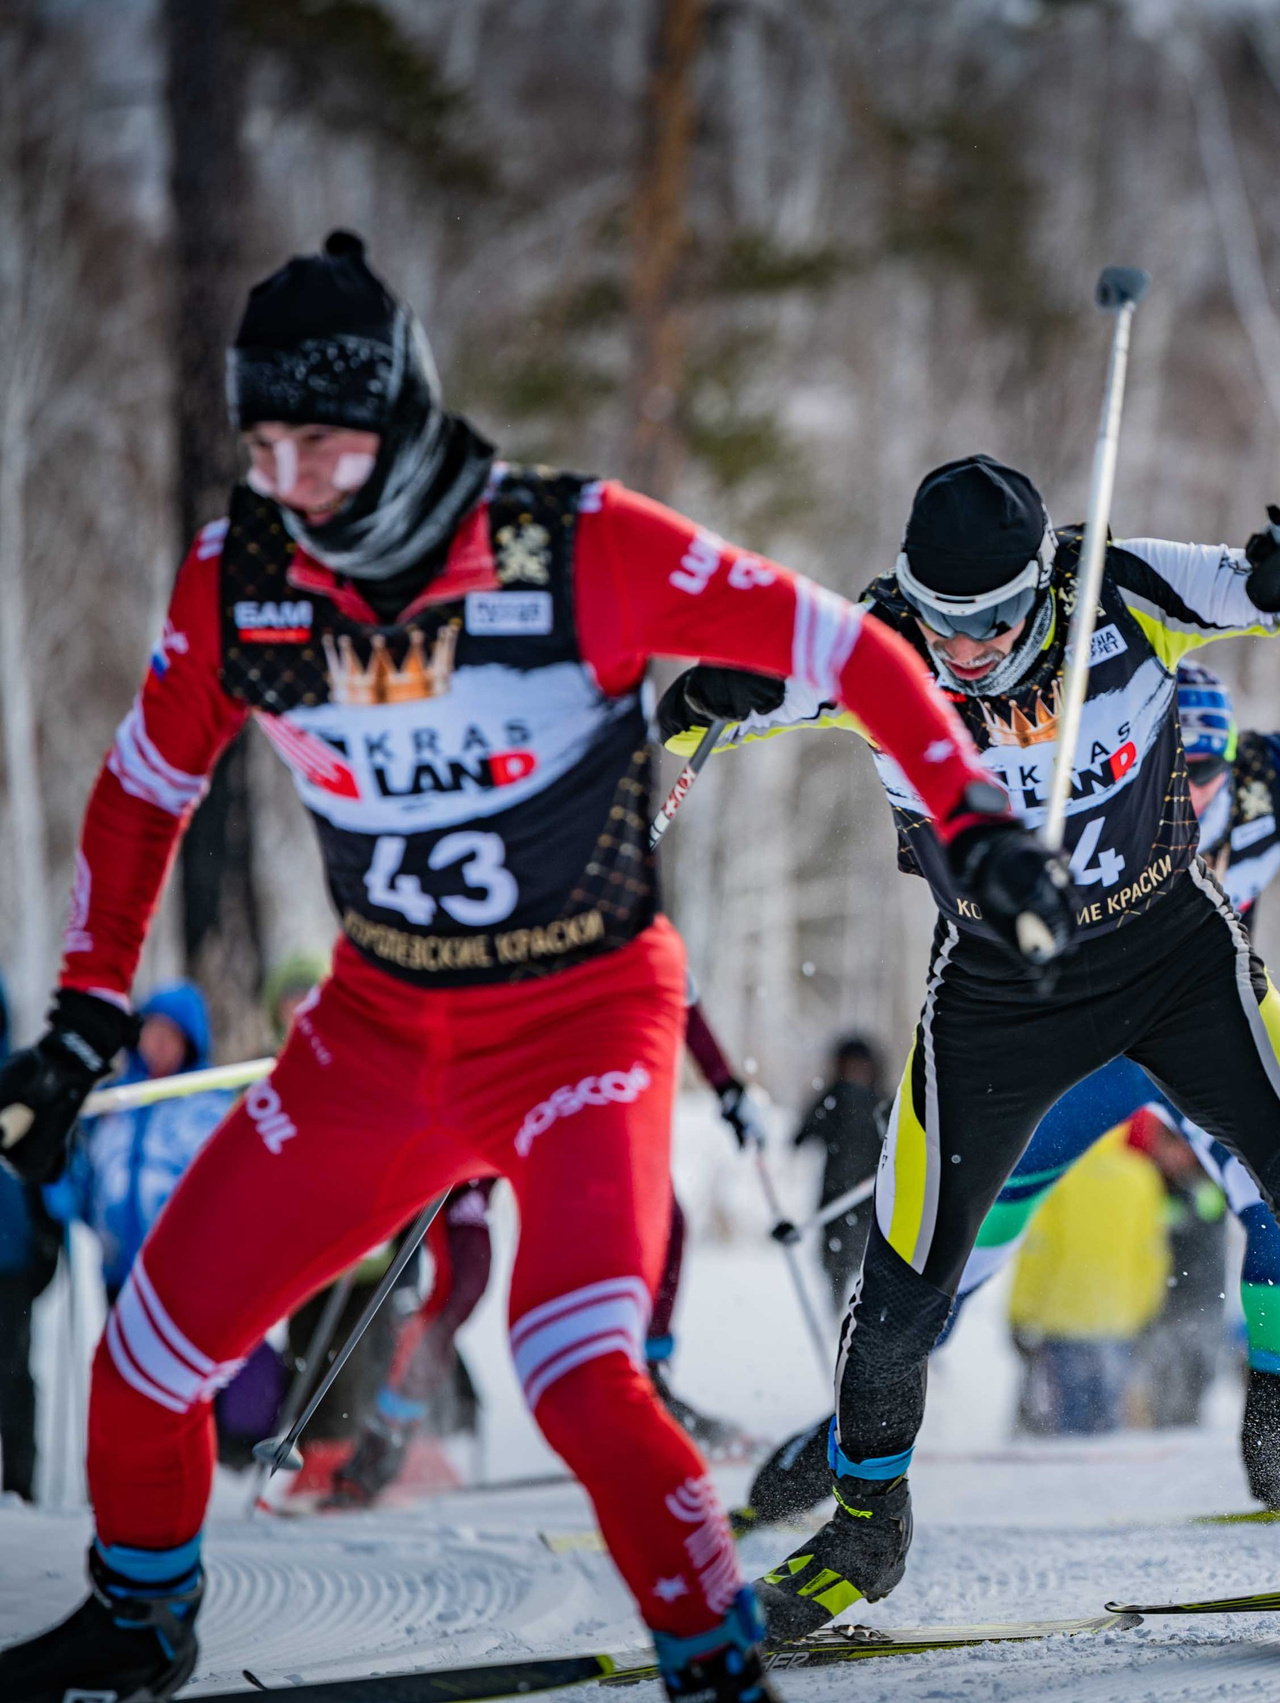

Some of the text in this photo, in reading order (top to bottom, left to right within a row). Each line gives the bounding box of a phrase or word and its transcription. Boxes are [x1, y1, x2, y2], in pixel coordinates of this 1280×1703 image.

[363, 719, 532, 760] KRAS
[1018, 720, 1133, 788] KAS
[371, 748, 538, 798] LAND
[362, 829, 520, 927] 43
[1107, 854, 1172, 915] КРАСКИ
[493, 906, 605, 965] КРАСКИ
